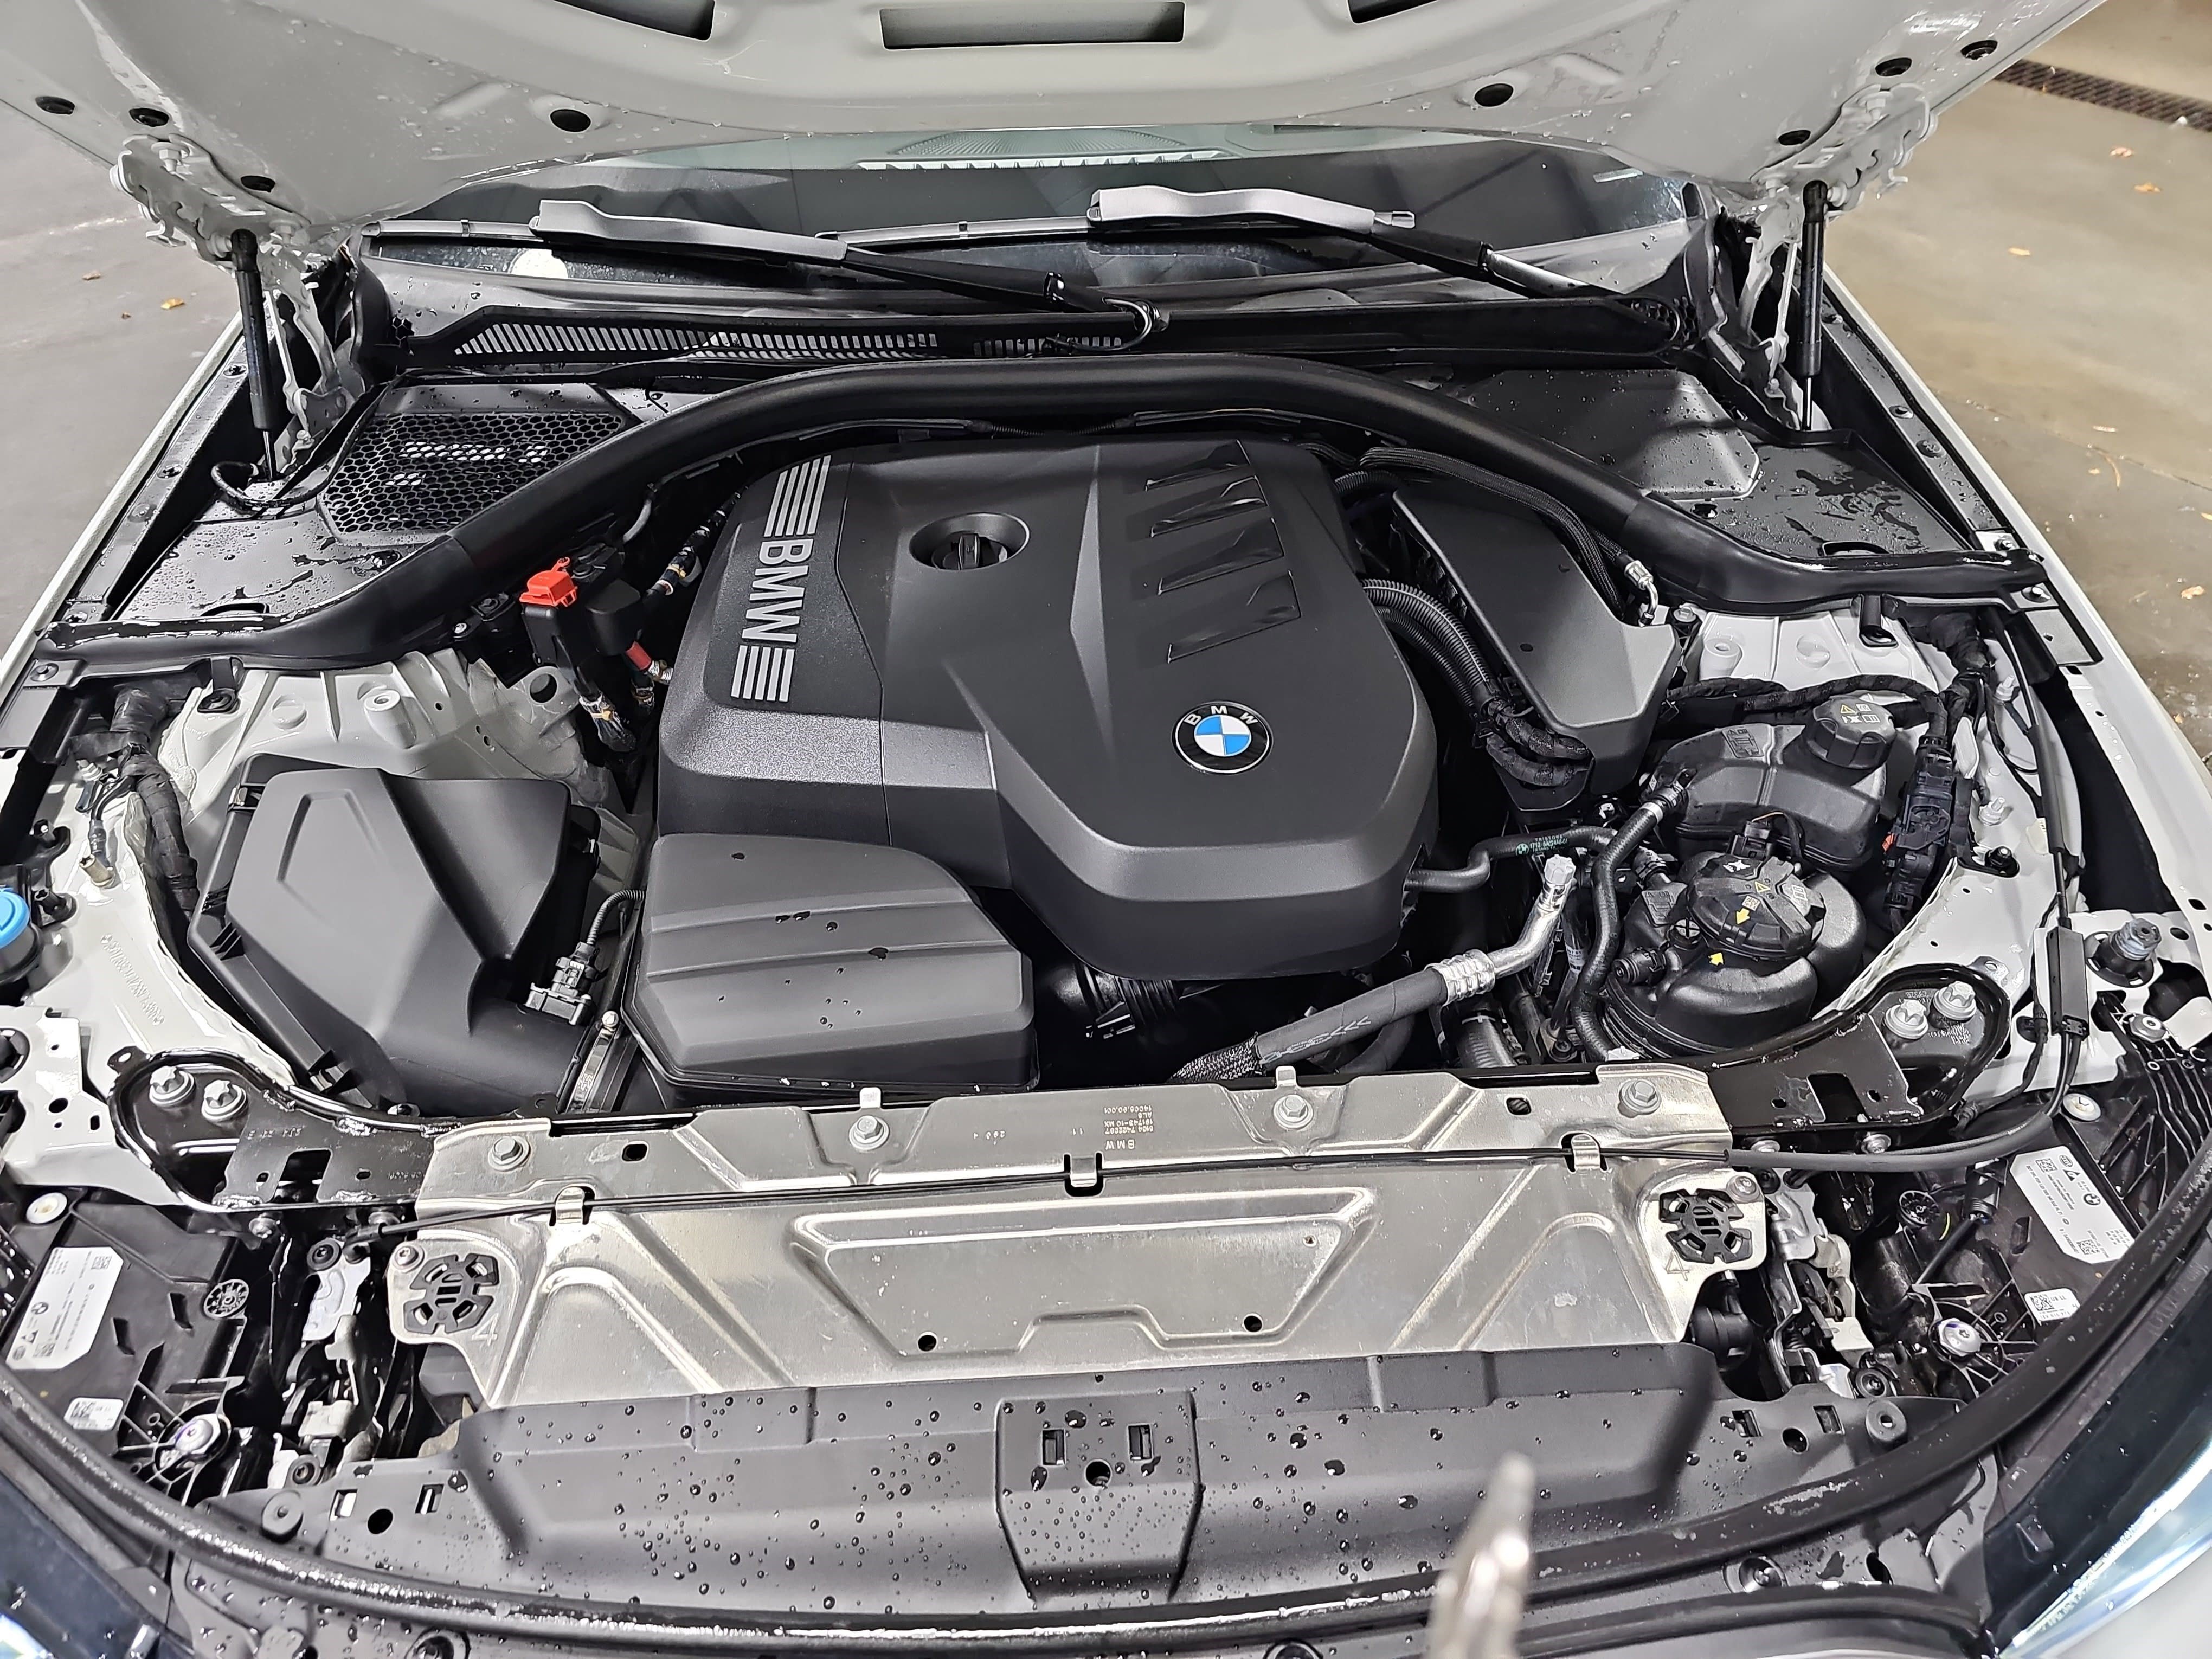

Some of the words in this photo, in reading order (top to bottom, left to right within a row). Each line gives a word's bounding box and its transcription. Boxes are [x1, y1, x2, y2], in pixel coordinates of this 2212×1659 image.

[742, 538, 813, 643] BMW
[1184, 705, 1258, 726] BMW
[1105, 1139, 1135, 1150] BMW
[1666, 1250, 1689, 1281] 4
[472, 1313, 498, 1346] 4
